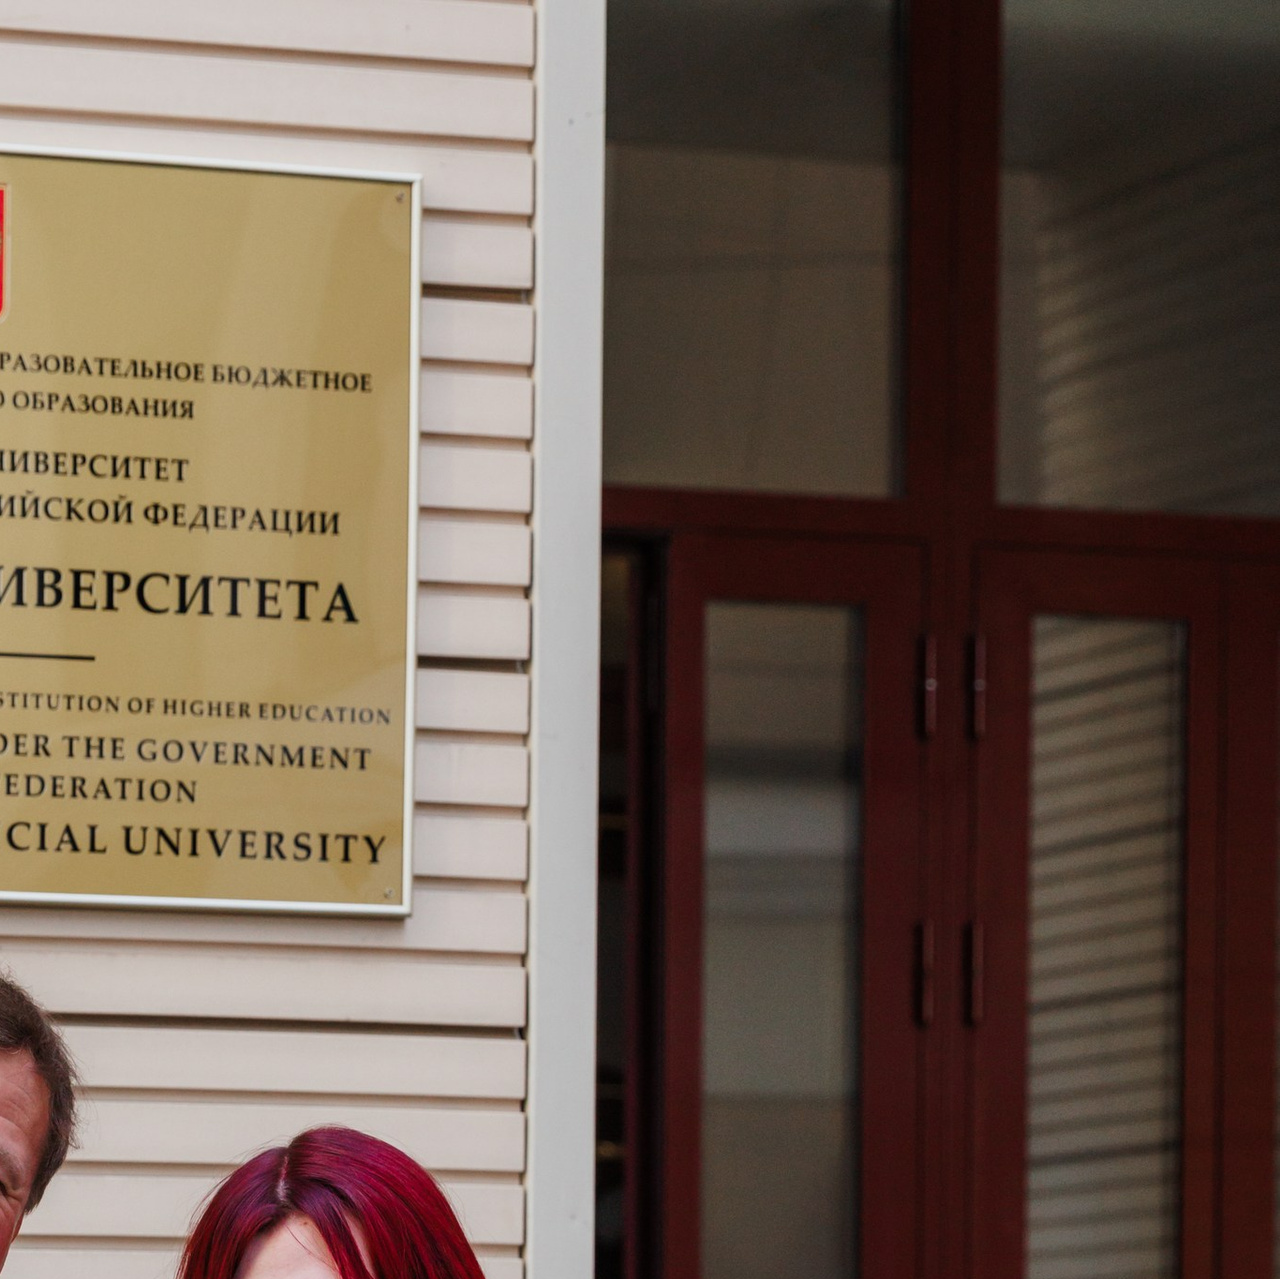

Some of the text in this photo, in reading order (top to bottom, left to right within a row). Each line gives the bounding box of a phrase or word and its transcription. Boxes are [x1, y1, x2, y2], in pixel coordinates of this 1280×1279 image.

[211, 364, 372, 394] БЮДЖЕТНОЕ
[11, 390, 195, 421] ОБРАЗОВАНИЯ
[142, 501, 340, 538] ФЕДЕРАЦИИ
[126, 696, 155, 715] OF
[162, 698, 252, 719] HIGHER
[258, 702, 390, 725] EDUCATION
[61, 735, 125, 761] THE
[136, 738, 372, 771] GOVERNMENT
[121, 825, 387, 865] UNIVERSITY
